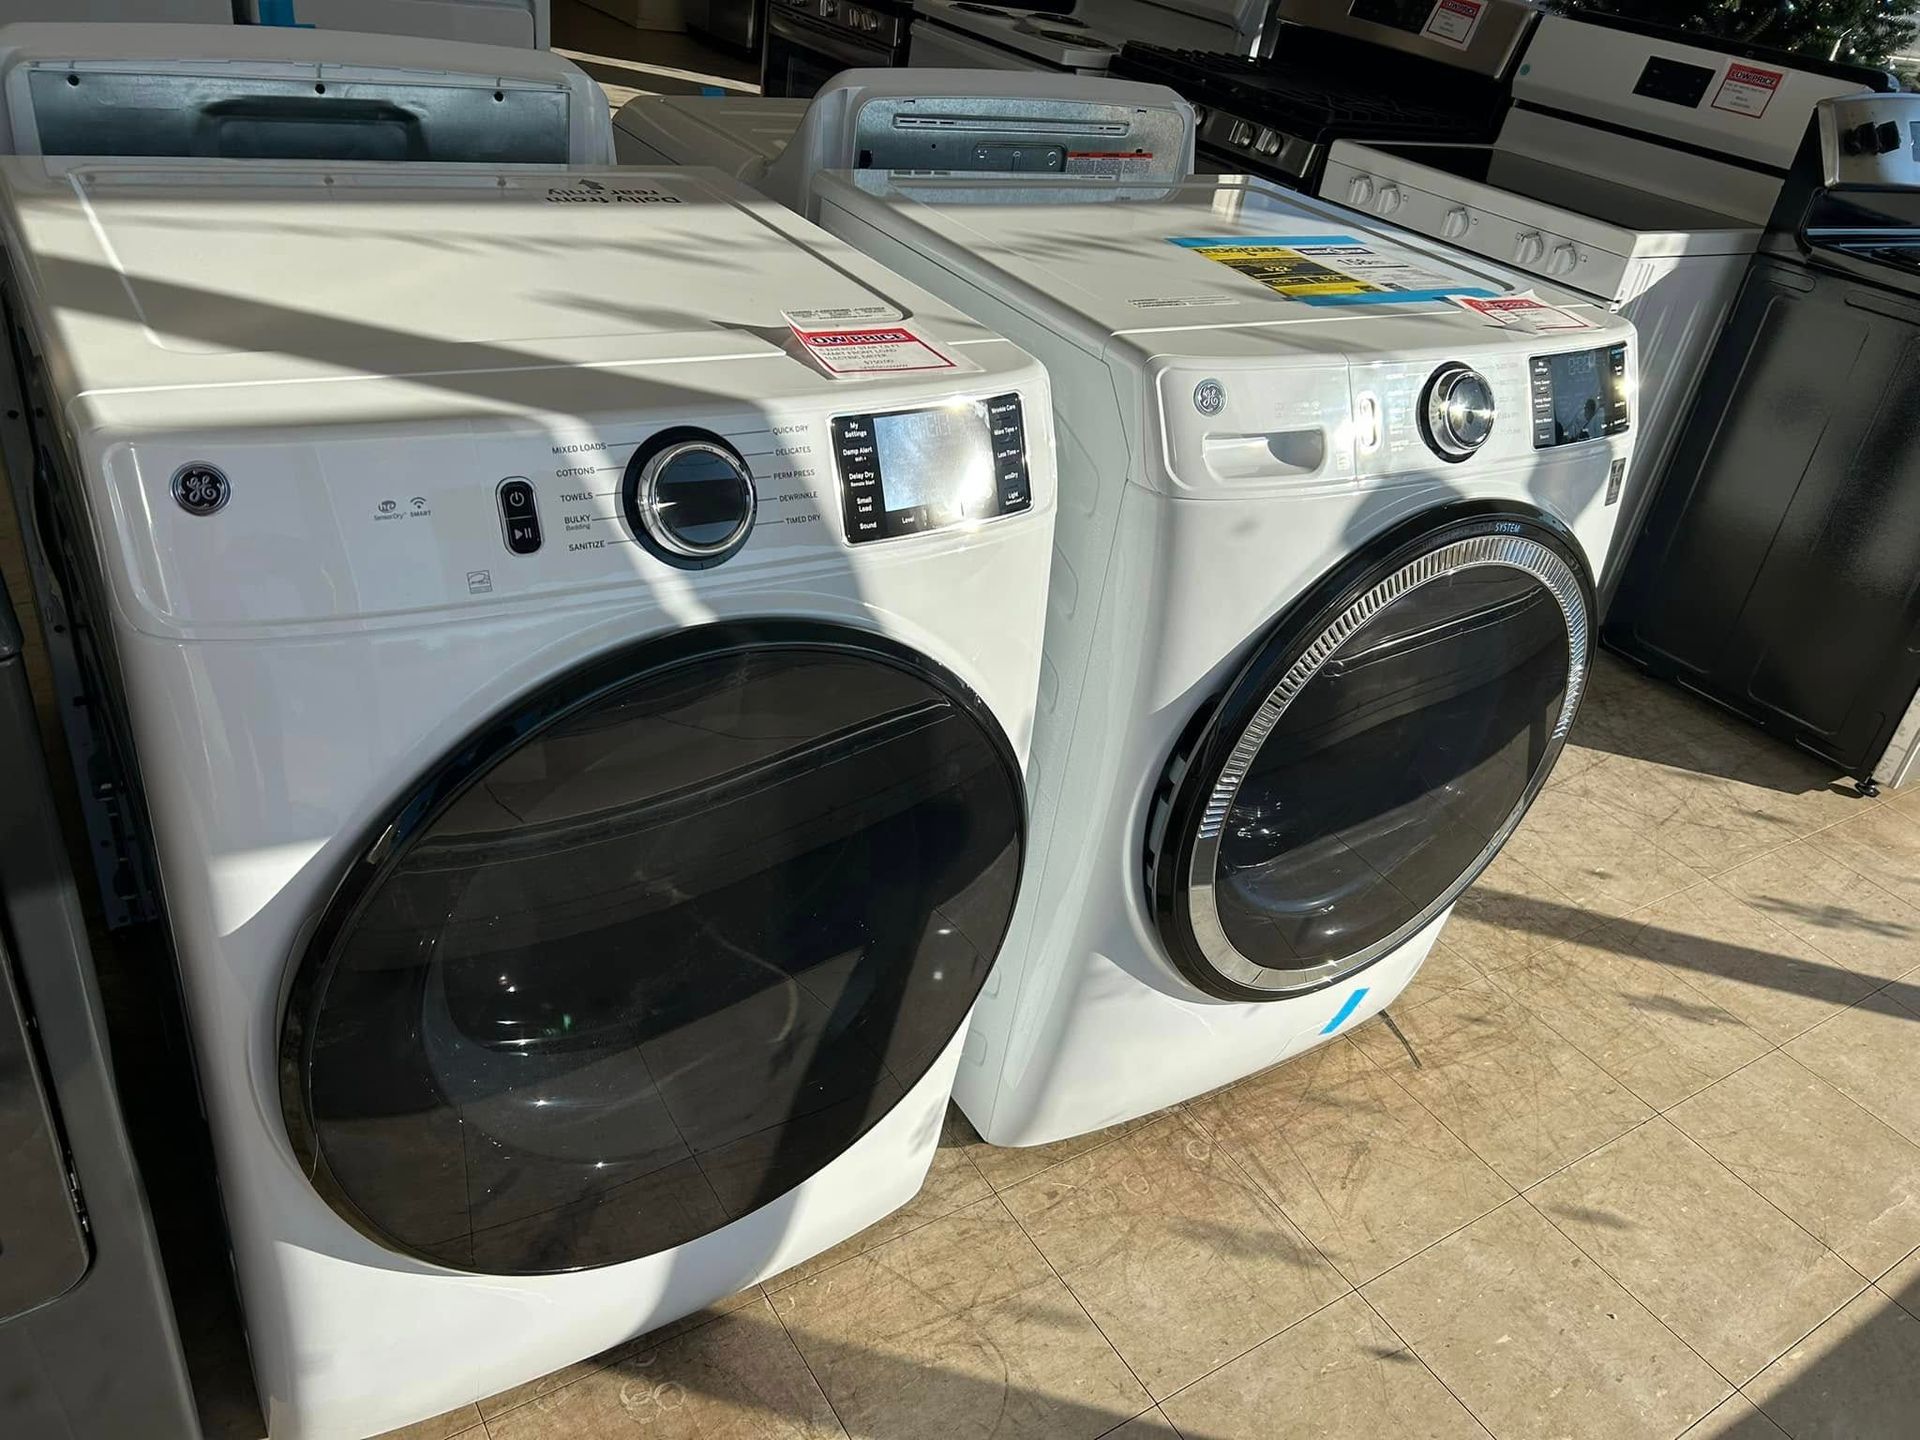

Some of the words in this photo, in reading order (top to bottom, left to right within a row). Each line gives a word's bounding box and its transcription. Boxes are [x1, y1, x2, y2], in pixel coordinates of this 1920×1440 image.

[1730, 69, 1750, 80] LOW
[1751, 74, 1777, 85] PRICE
[809, 336, 848, 346] OW
[849, 333, 904, 342] PRICE
[772, 427, 793, 436] QUICK
[794, 425, 809, 433] DRY
[850, 421, 859, 430] My
[844, 431, 868, 439] Settings
[552, 445, 579, 454] MIXED
[580, 442, 607, 452] LOADS
[775, 446, 811, 456] DELICATES
[842, 448, 859, 456] Damp
[859, 446, 873, 454] Alert
[556, 467, 595, 478] COTTONS
[773, 471, 793, 480] PERM
[794, 469, 815, 478] PRESS
[864, 471, 874, 480] Dry
[560, 492, 593, 502] TOWELS
[779, 492, 818, 502] DEWRINKLE
[857, 496, 873, 504] Small
[1008, 491, 1019, 499] Light
[858, 504, 873, 512] Load
[410, 510, 432, 518] SMART
[564, 514, 591, 525] BULKY
[785, 516, 805, 525] TIMED
[806, 514, 822, 523] DRY
[902, 515, 915, 524] Level
[860, 521, 877, 530] Sound
[1494, 521, 1521, 533] SYSTEM
[568, 540, 605, 552] SANITIZE
